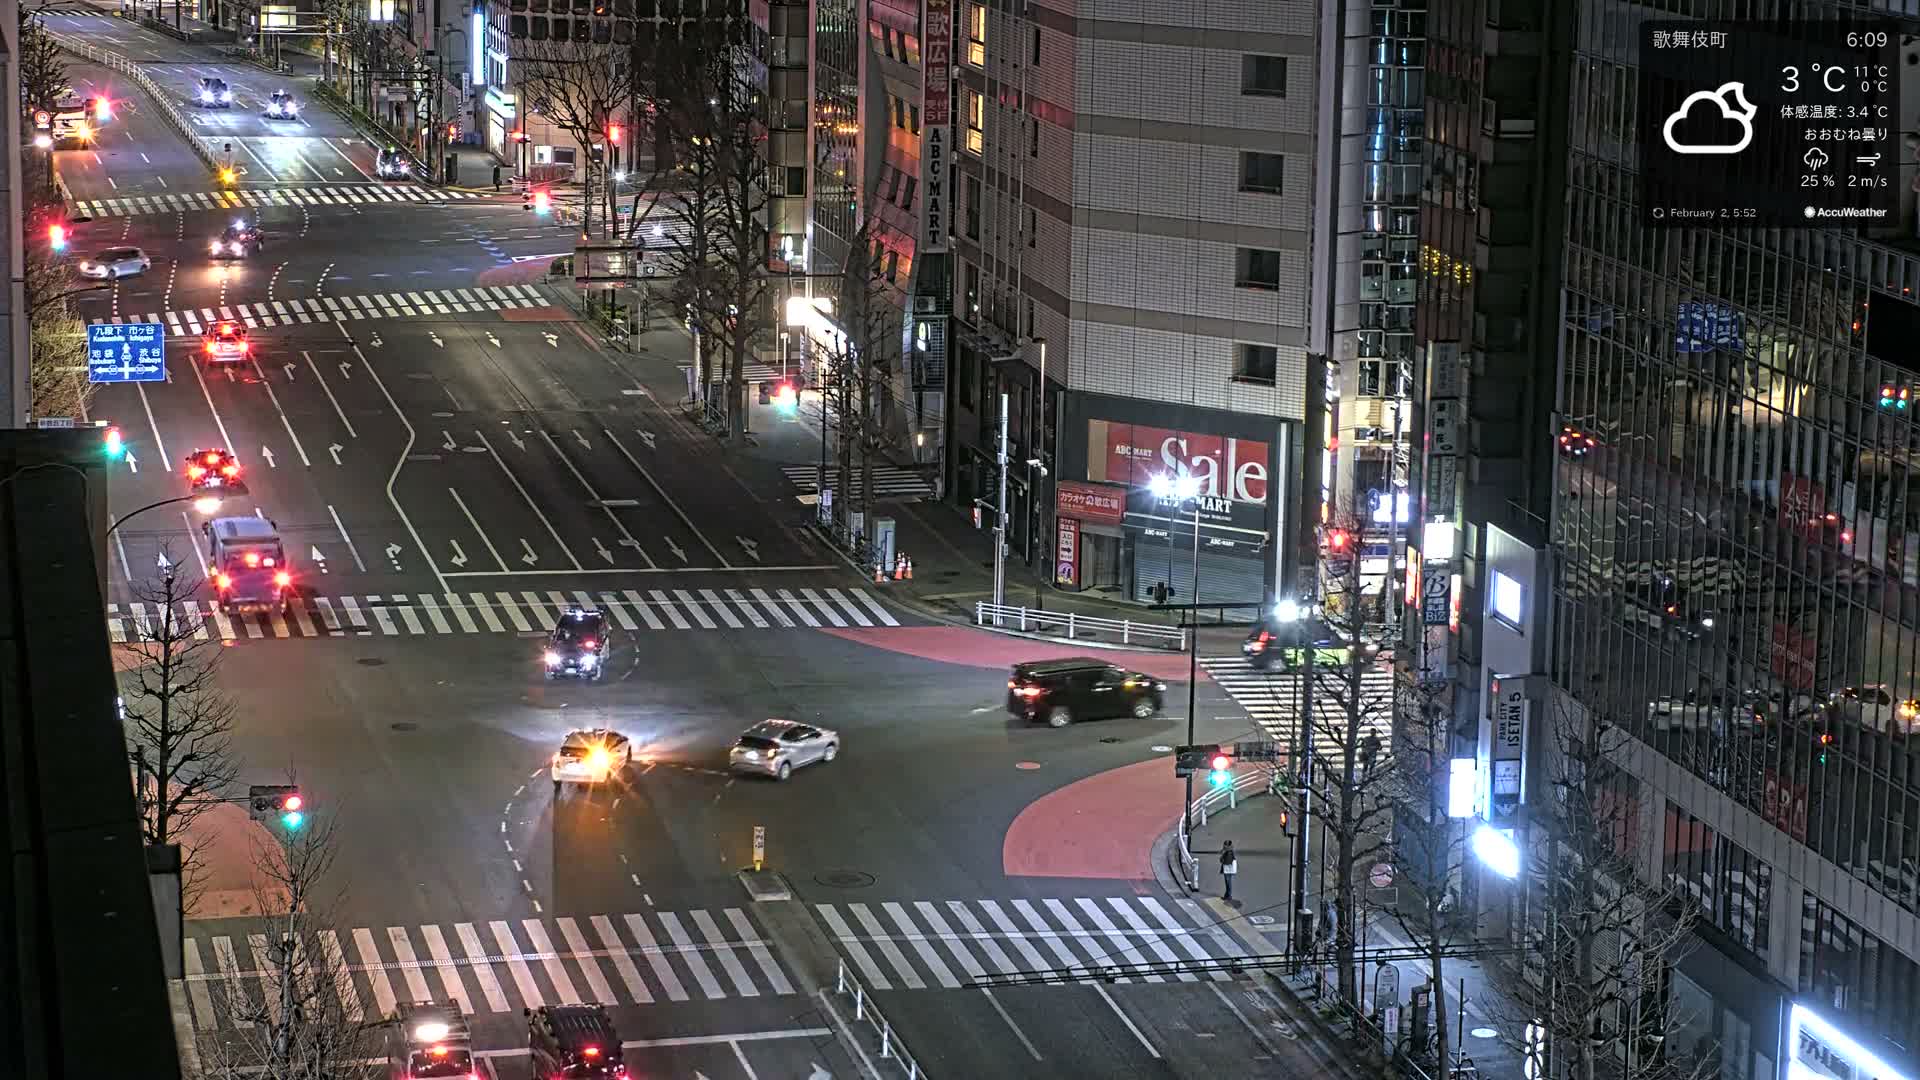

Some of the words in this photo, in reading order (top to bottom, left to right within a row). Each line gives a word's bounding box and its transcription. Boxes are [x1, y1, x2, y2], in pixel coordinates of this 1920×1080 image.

[926, 11, 949, 92] 歌広場
[926, 112, 948, 121] 5F
[96, 327, 123, 336] 九段下
[1115, 444, 1153, 456] ABCMART
[1160, 437, 1268, 504] Sale
[1509, 691, 1521, 702] 5
[1507, 704, 1521, 747] ISETAN
